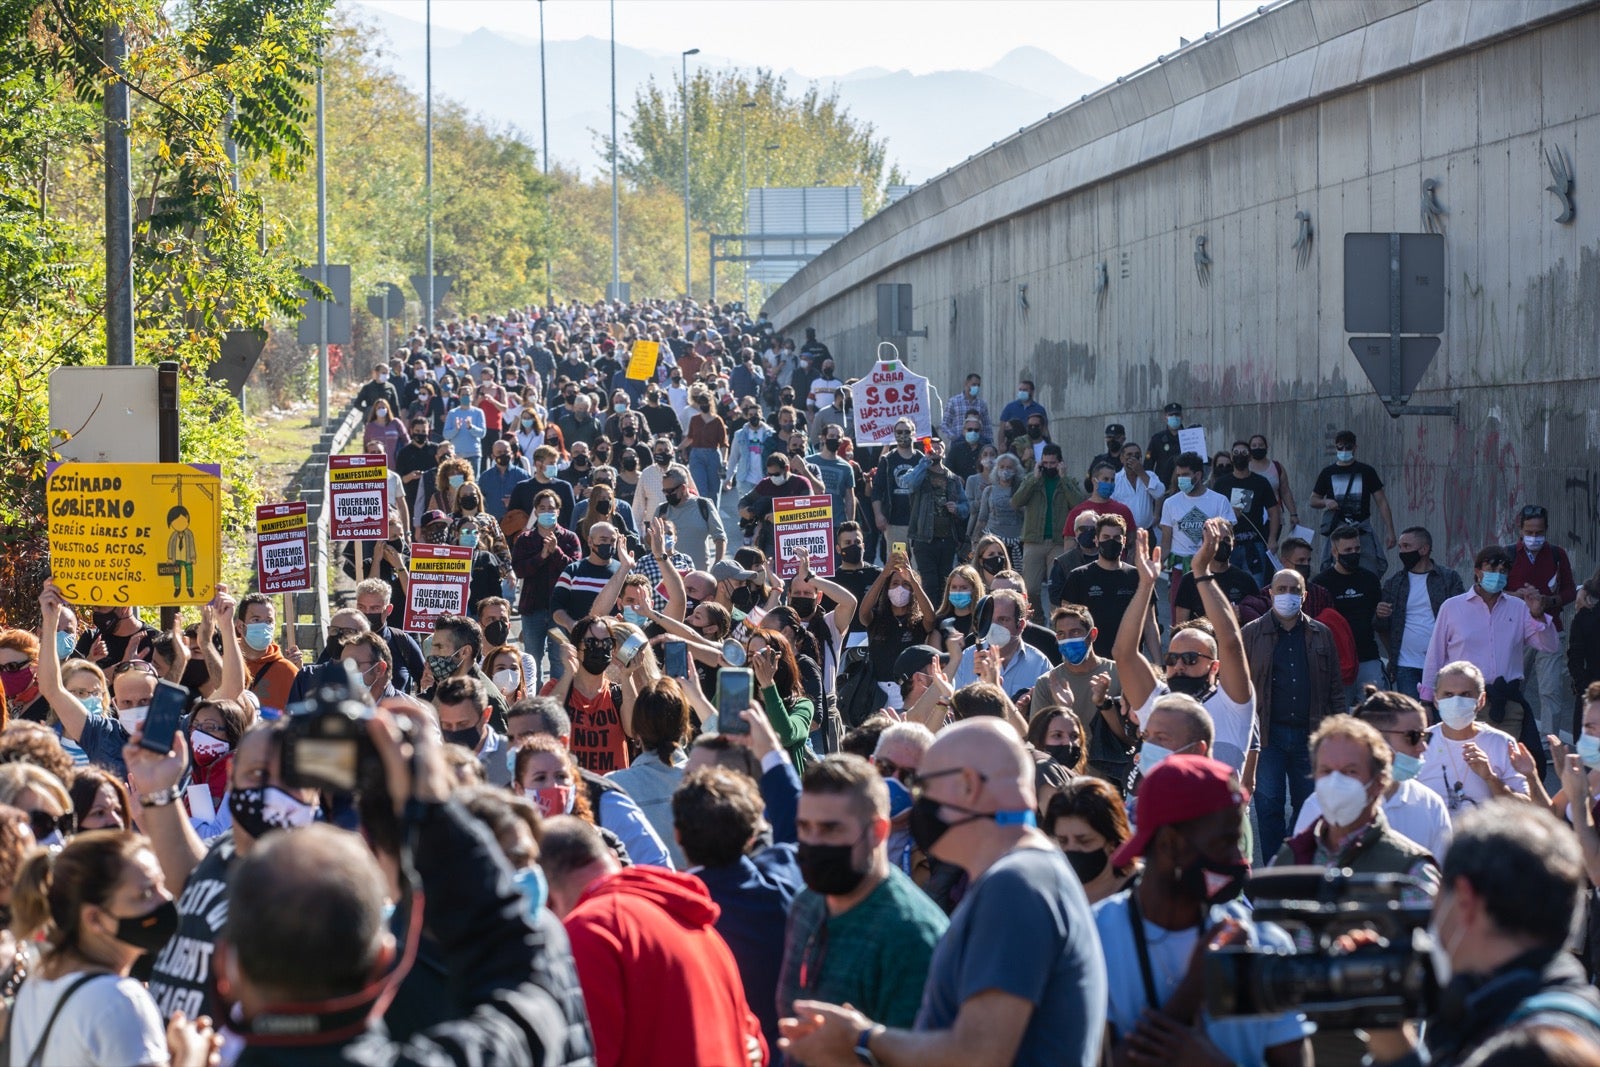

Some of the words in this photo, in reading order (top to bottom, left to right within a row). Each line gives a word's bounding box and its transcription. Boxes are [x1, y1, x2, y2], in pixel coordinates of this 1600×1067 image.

[860, 420, 878, 434] NOS
[335, 467, 382, 480] MANIFESTACIÓN
[339, 497, 379, 506] ¡QUEREMOS
[337, 506, 381, 516] TRABAJAR!
[779, 508, 827, 522] MANIFESTACIÓN
[261, 515, 304, 532] MANIFESTACIÓN
[777, 523, 809, 531] RESTAURANTE
[1180, 521, 1204, 529] CENTR
[135, 527, 151, 538] DE
[353, 528, 381, 536] GABIAS
[784, 536, 825, 547] ¡QUEREMOS
[53, 541, 99, 553] VUESTROS
[105, 543, 147, 556] ACTOS,
[266, 546, 302, 559] ¡QUEREMOS
[54, 557, 76, 568] PERO
[78, 559, 91, 568] NO
[94, 559, 106, 568] DE
[109, 558, 131, 568] SUS
[265, 556, 304, 569] TRABAJAR!
[415, 560, 466, 570] MANIFESTACIÓN
[411, 573, 444, 581] RESTAURANTE
[265, 582, 280, 590] LAS
[281, 579, 306, 588] GABIAS
[416, 588, 459, 600] ¡QUEREMOS
[414, 598, 459, 610] TRABAJAR!
[589, 708, 618, 727] YOU
[574, 728, 609, 747] NOT
[571, 750, 618, 771] HEM.
